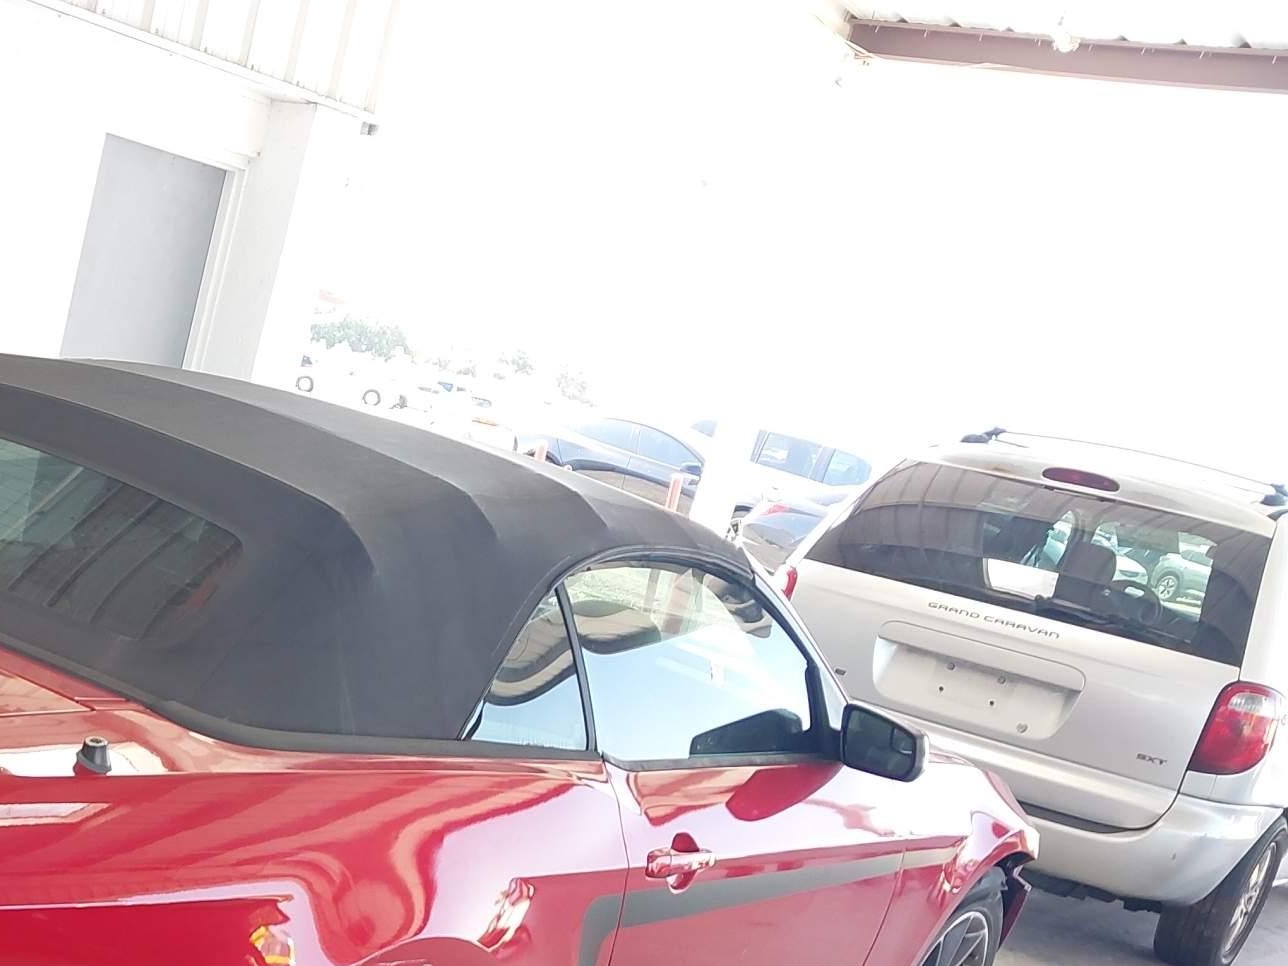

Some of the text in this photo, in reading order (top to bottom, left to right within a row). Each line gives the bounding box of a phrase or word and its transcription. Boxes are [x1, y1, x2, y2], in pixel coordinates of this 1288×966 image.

[927, 601, 1060, 640] GRAND CARAVAN
[1136, 752, 1168, 766] SXT
